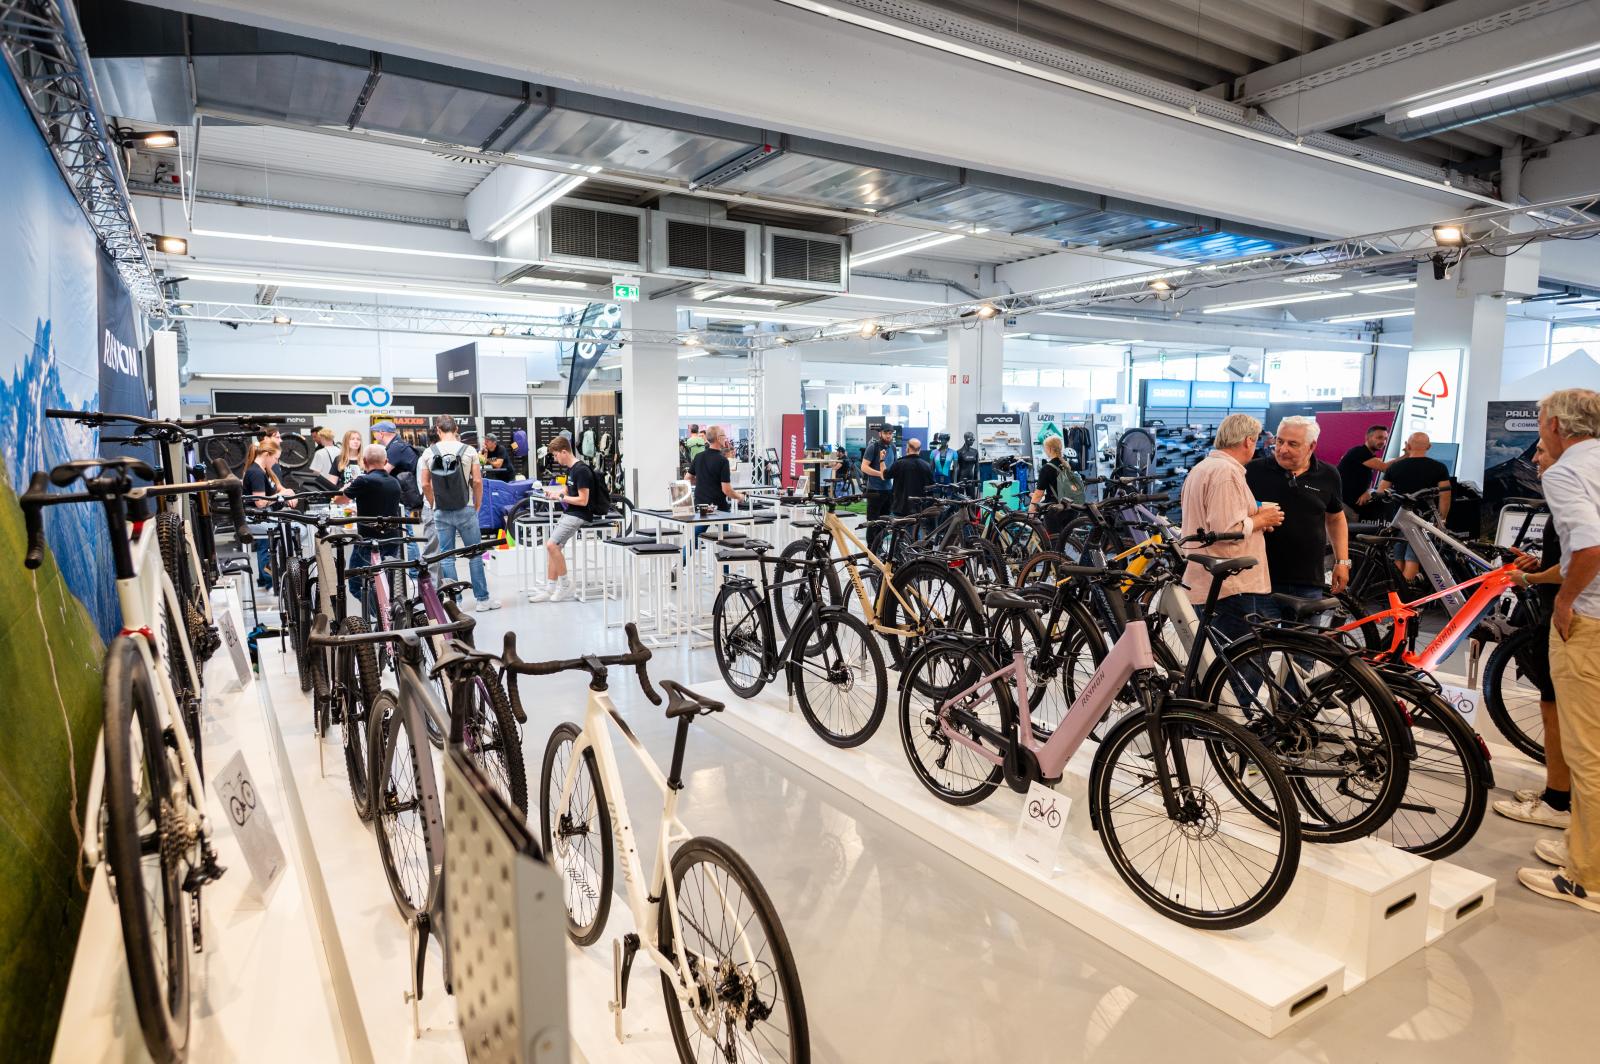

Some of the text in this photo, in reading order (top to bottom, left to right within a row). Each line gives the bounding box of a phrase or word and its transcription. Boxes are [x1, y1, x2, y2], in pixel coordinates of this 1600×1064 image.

[104, 328, 138, 377] RAYMON
[1098, 588, 1117, 625] RAYMON
[1081, 671, 1105, 707] RAYMON
